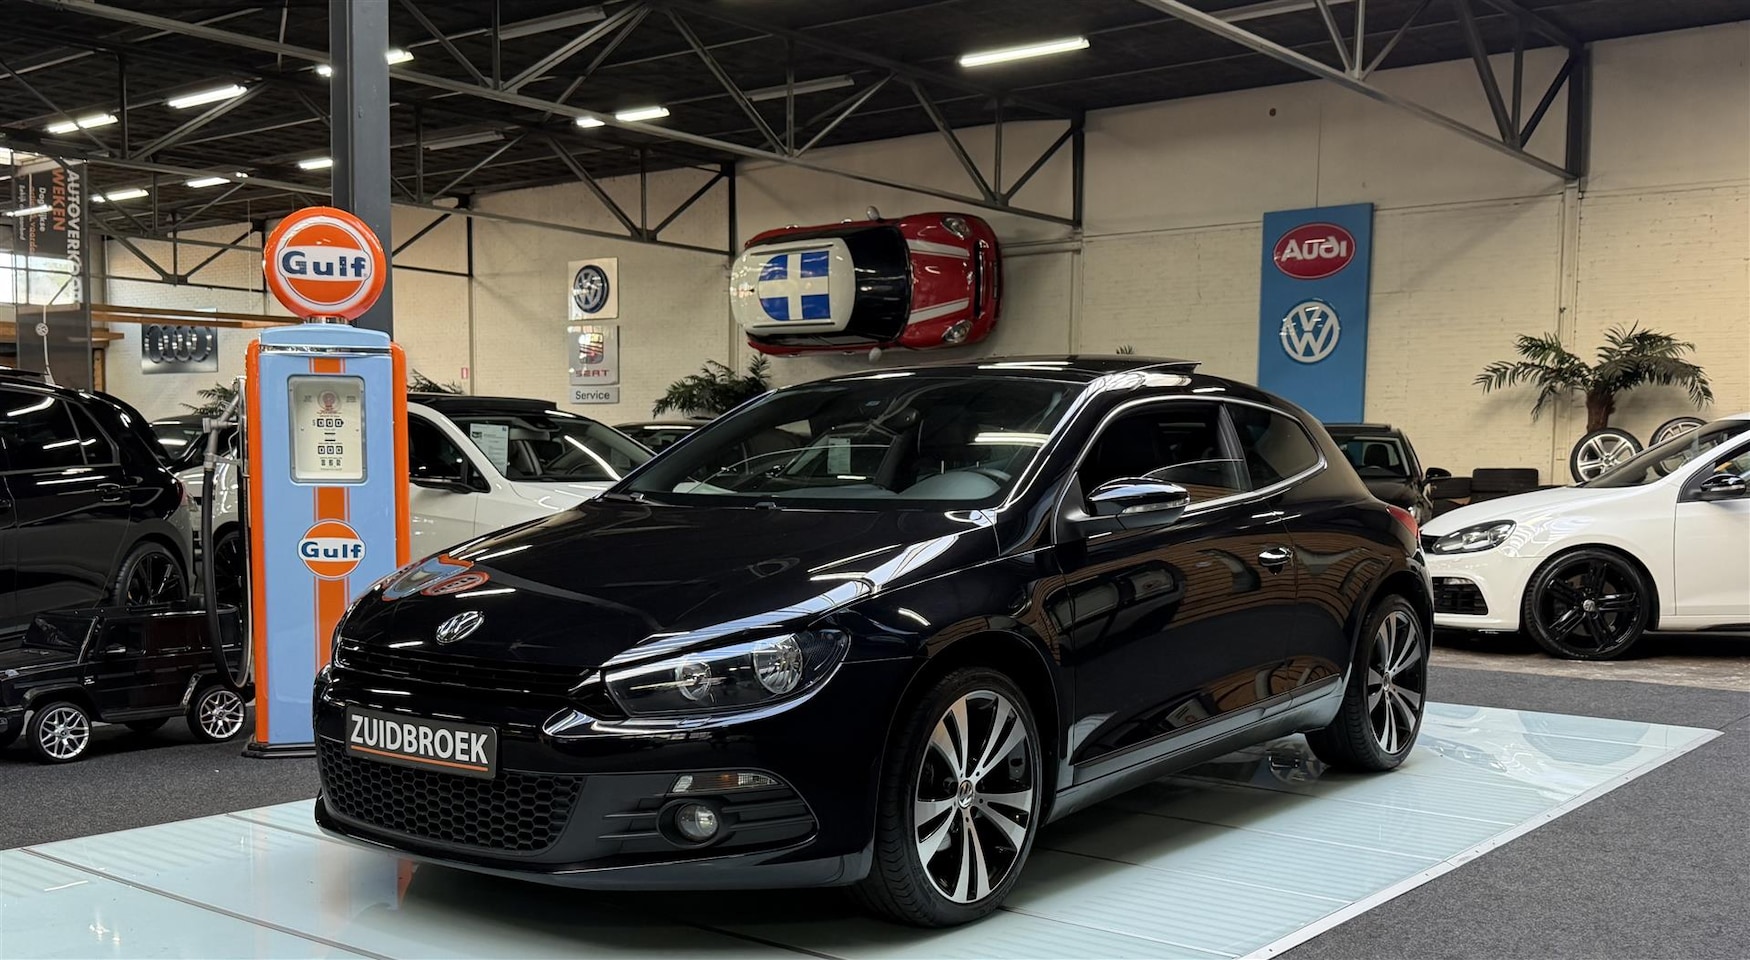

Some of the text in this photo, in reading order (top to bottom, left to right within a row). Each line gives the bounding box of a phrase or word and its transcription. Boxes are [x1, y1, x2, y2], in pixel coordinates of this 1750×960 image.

[52, 168, 66, 231] WEKEN
[282, 251, 366, 277] Gulf
[576, 369, 610, 377] SEAT
[575, 390, 610, 400] Service
[301, 541, 361, 558] Gulf
[350, 714, 489, 764] ZUIDBROEK
